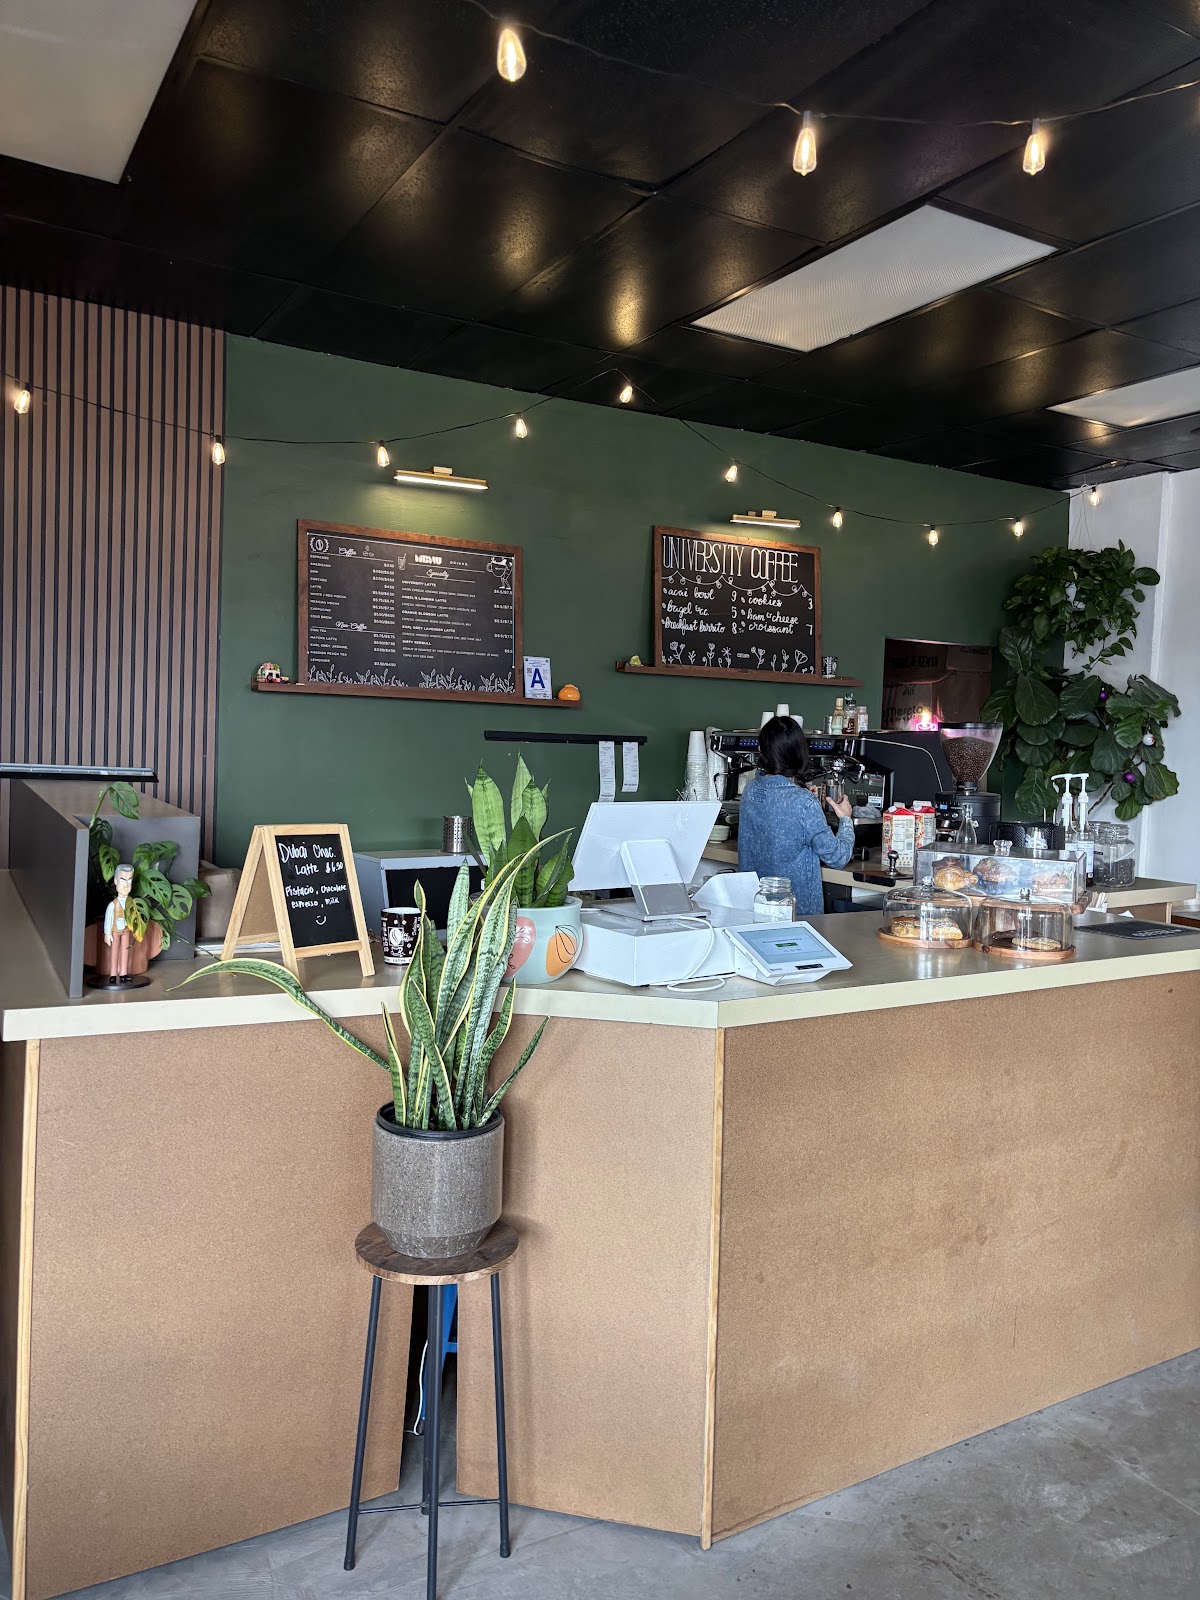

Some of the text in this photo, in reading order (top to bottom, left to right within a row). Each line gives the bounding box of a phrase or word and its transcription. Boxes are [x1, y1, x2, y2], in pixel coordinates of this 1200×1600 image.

[415, 554, 442, 565] MENU
[663, 536, 798, 583] UNIVERSITY COFFEE
[694, 587, 715, 600] bowl
[731, 590, 737, 602] 9
[749, 594, 782, 607] cookies
[807, 598, 813, 610] 3
[667, 600, 692, 618] bagel
[731, 606, 737, 618] 5
[747, 608, 765, 621] ham
[664, 617, 725, 635] breakfast burrito
[749, 622, 794, 634] croissant
[806, 624, 813, 636] 7
[531, 668, 545, 688] A
[278, 841, 308, 863] Dubai
[295, 863, 319, 875] Latte
